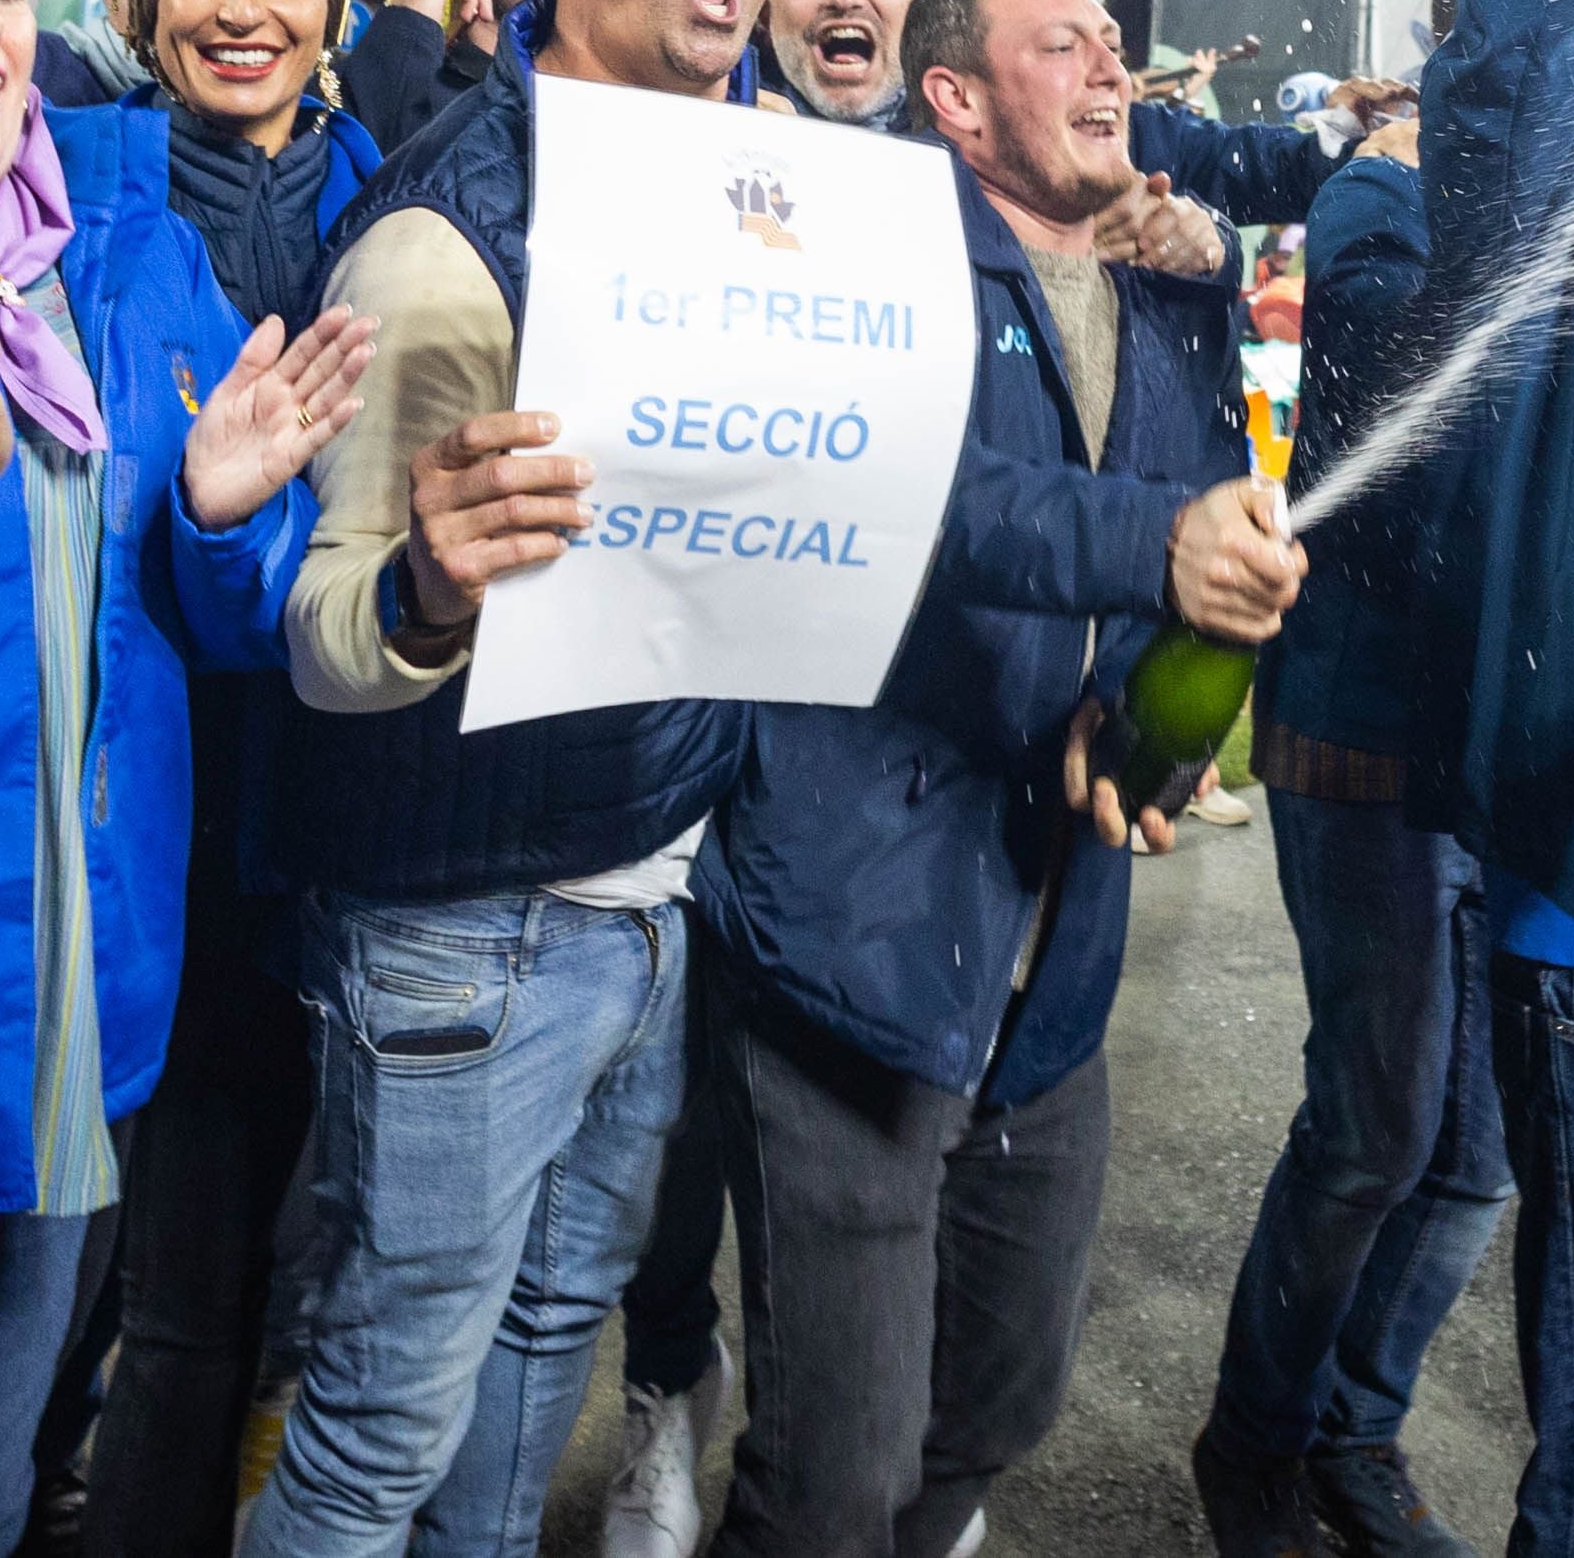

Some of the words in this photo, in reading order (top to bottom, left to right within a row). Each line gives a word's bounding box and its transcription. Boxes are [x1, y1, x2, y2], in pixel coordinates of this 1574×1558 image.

[605, 271, 701, 330] 1er
[720, 284, 915, 351] PREMI
[625, 395, 871, 463] SECCIÓ
